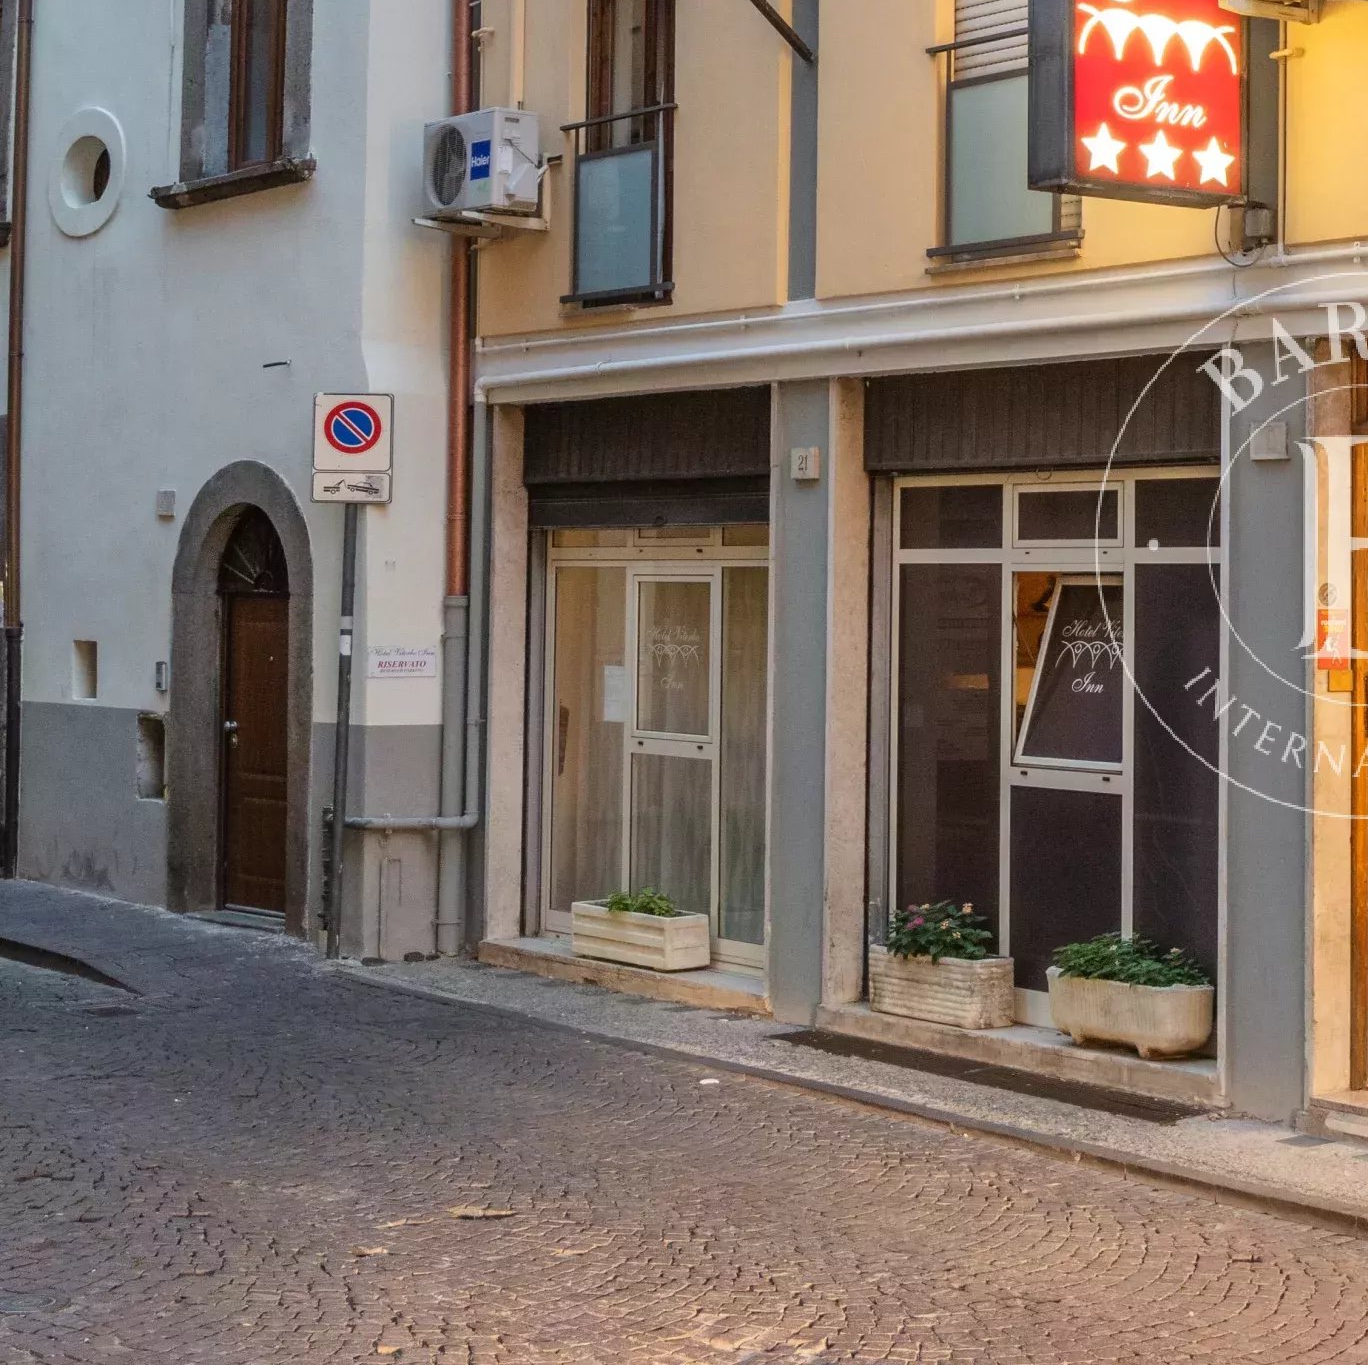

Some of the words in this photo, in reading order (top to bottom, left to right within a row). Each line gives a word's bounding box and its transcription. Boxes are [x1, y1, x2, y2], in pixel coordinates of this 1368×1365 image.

[1113, 74, 1207, 129] Inn
[471, 155, 490, 167] Haier
[798, 454, 808, 471] 21
[1062, 619, 1100, 638] Hotel
[1102, 619, 1124, 638] Vite
[377, 660, 427, 669] RISERVATO
[1071, 671, 1104, 694] Inn
